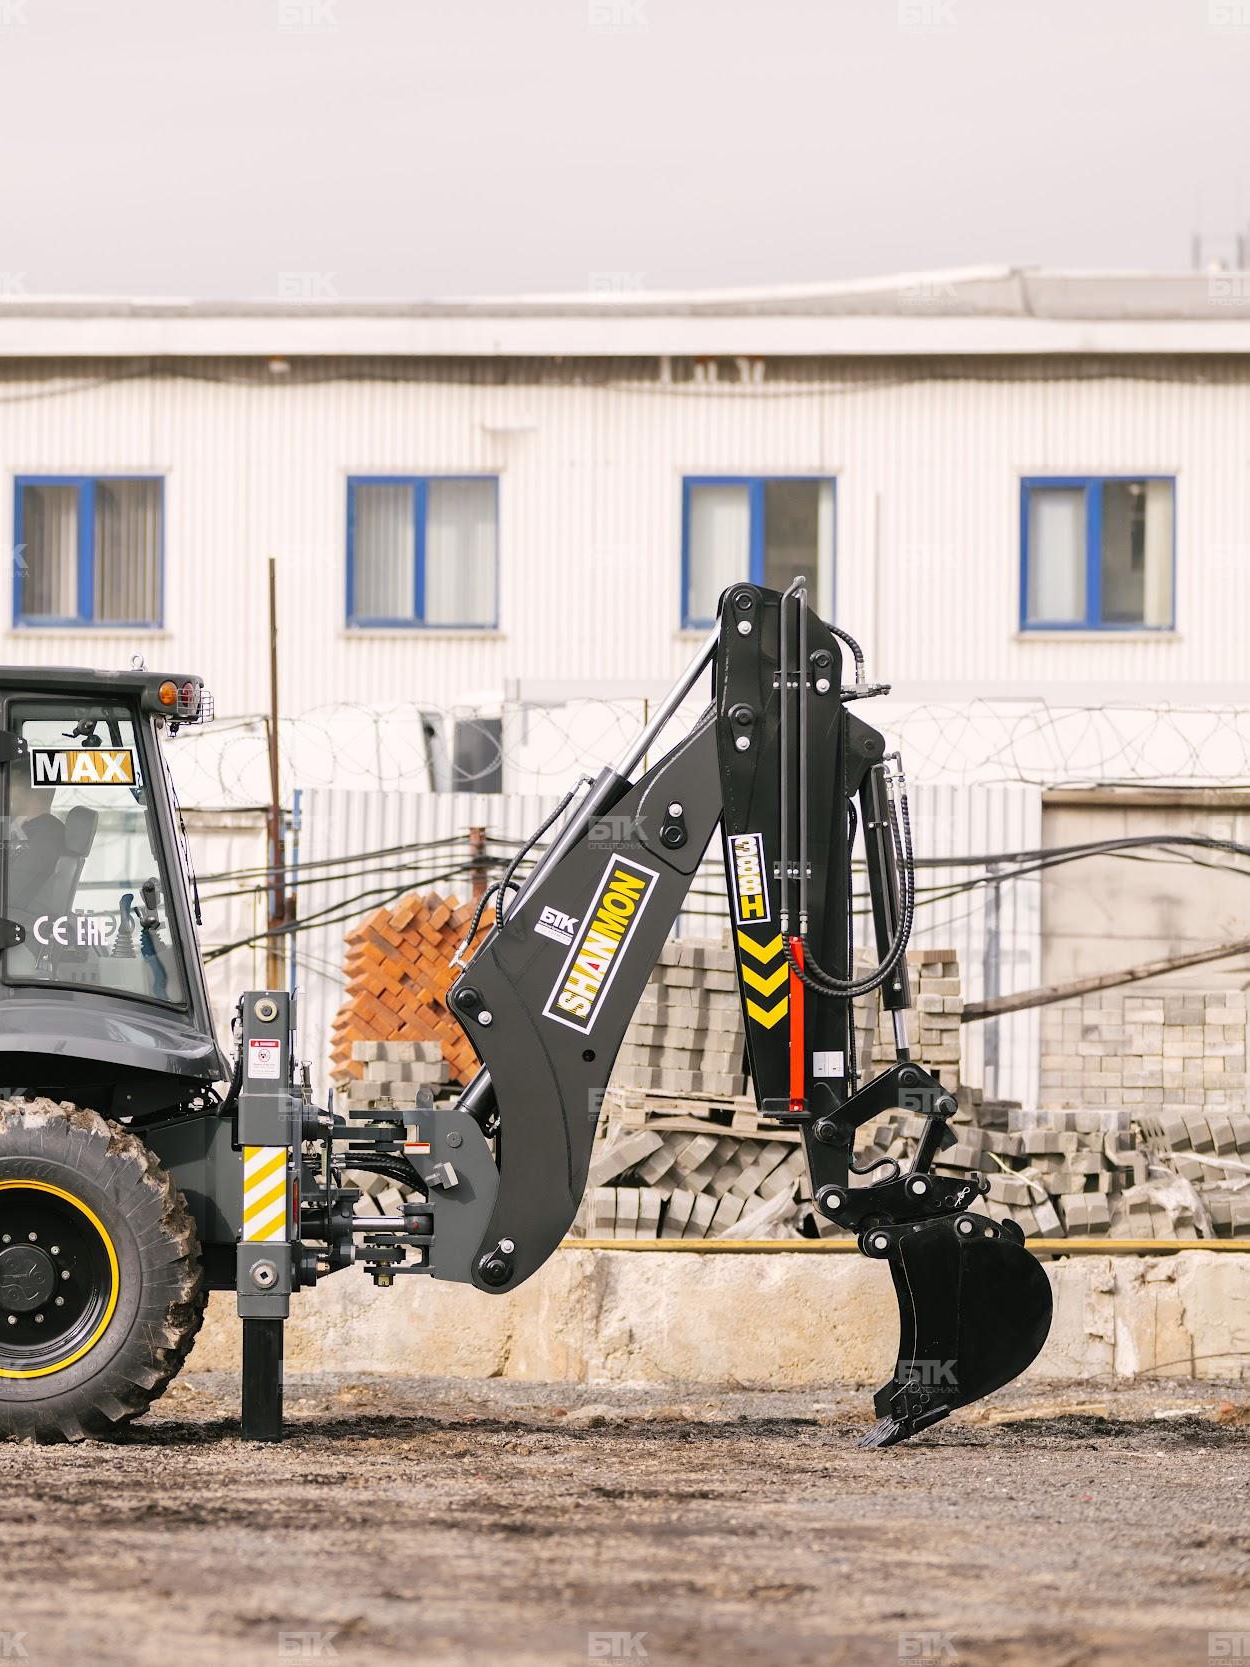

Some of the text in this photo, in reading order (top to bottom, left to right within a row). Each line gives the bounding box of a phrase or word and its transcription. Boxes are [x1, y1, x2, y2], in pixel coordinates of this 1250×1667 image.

[35, 752, 131, 782] MAX
[734, 836, 765, 919] 388H
[33, 915, 69, 946] CE
[540, 905, 579, 936] БТК
[556, 870, 646, 1021] SHANMON
